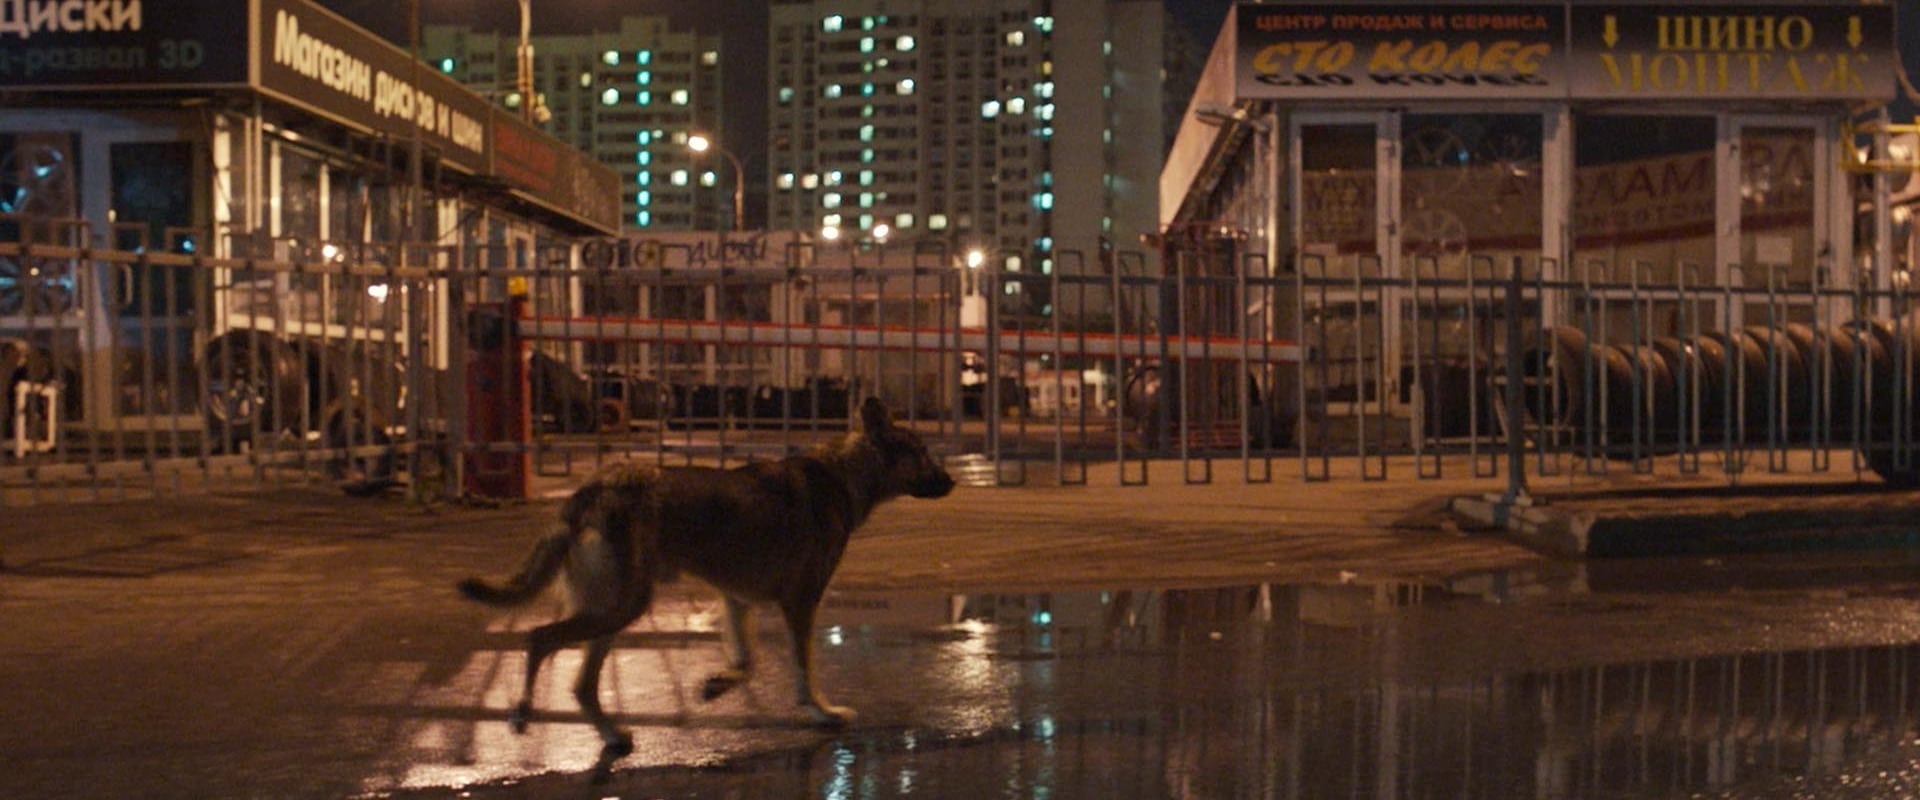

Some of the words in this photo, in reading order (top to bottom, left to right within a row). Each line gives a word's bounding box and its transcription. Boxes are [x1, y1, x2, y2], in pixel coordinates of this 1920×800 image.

[1256, 15, 1326, 31] ЦЕНТР
[1332, 15, 1424, 31] ПРОДАЖ
[1430, 15, 1445, 29] И
[1452, 15, 1547, 29] СЕРВИСА
[1657, 16, 1813, 50] ШИНО
[159, 38, 204, 70] 3D
[1253, 41, 1354, 74] СТО
[1368, 41, 1552, 74] КОЛЕС
[273, 8, 371, 102] Магазин
[437, 102, 449, 139] и
[1600, 52, 1870, 93] МОНТАЖ
